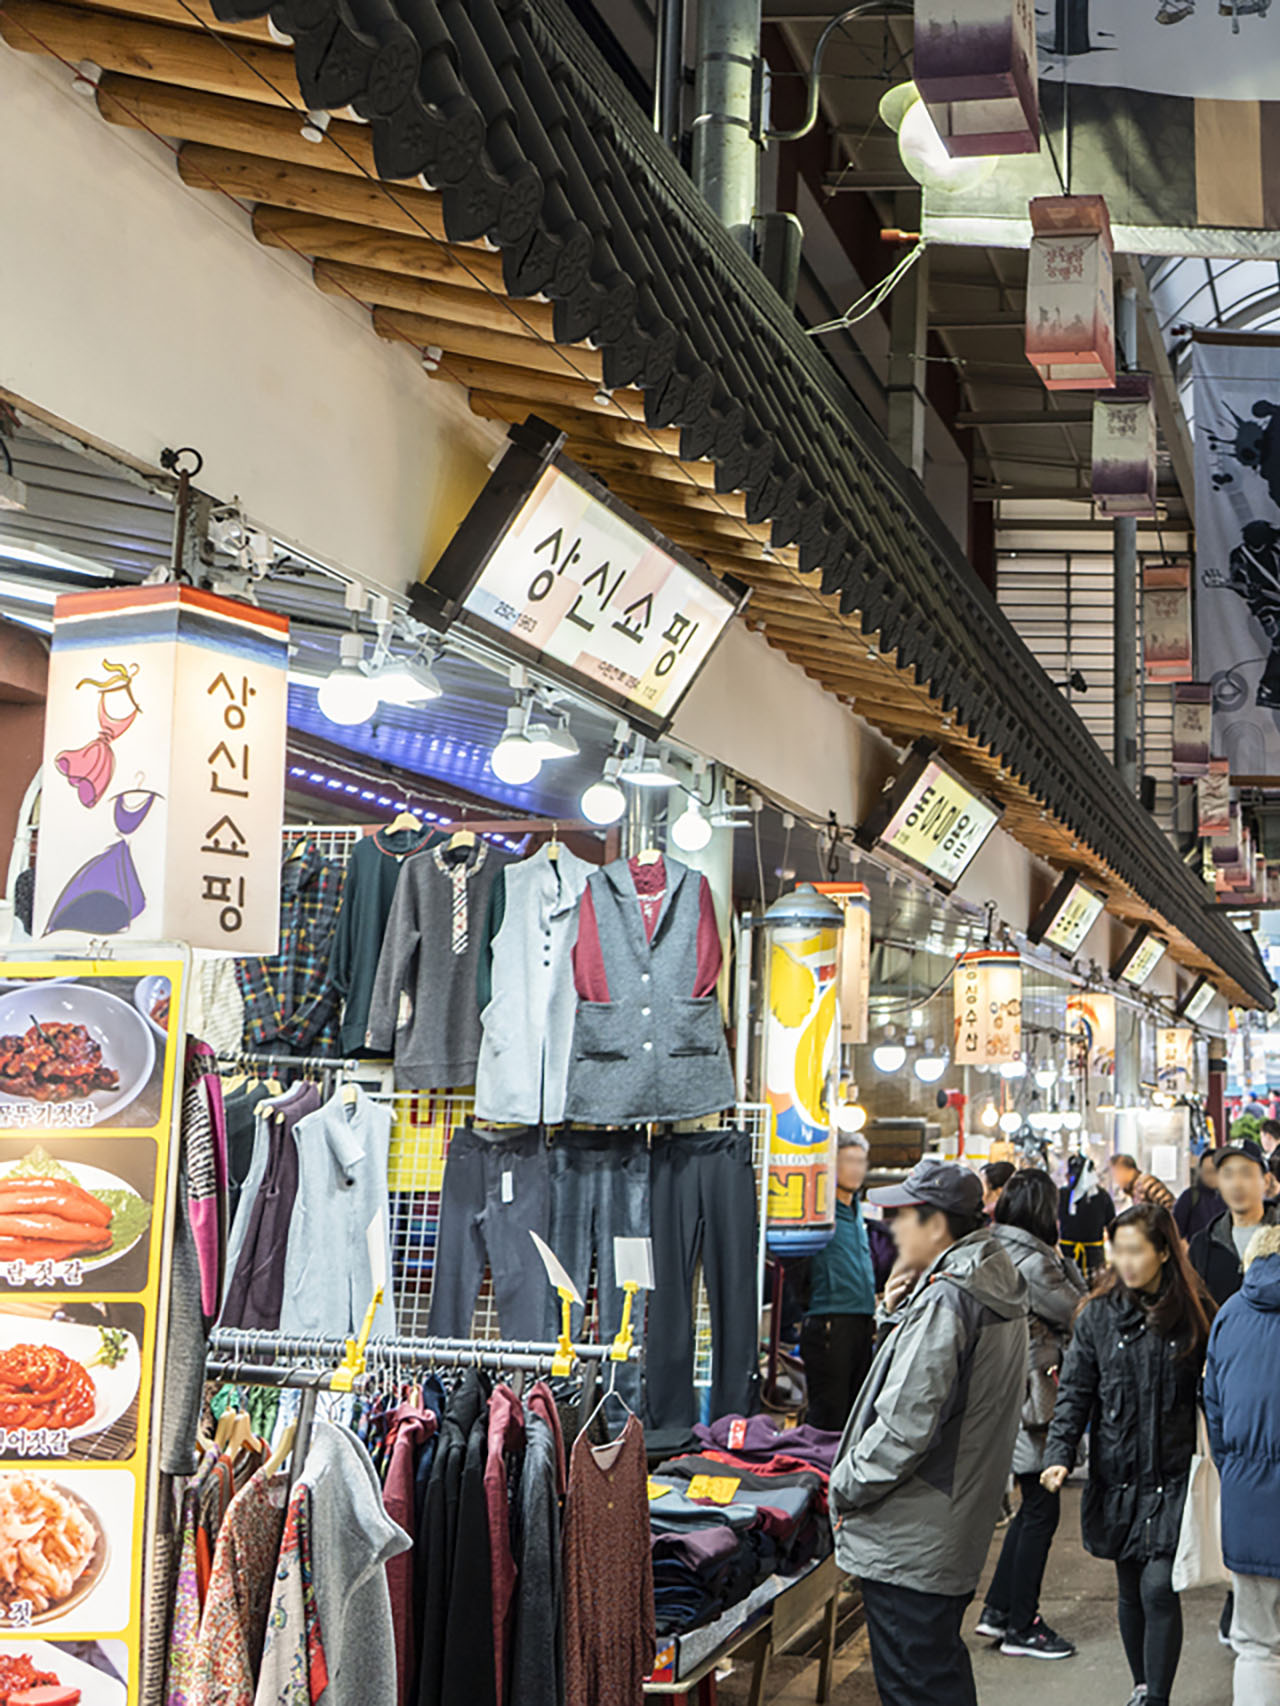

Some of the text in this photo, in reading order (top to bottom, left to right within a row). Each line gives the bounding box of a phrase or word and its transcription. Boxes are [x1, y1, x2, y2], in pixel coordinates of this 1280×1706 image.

[527, 527, 699, 677] 상신쇼핑
[201, 672, 257, 933] 상신쇼핑
[0, 1430, 70, 1452] 어젓갈
